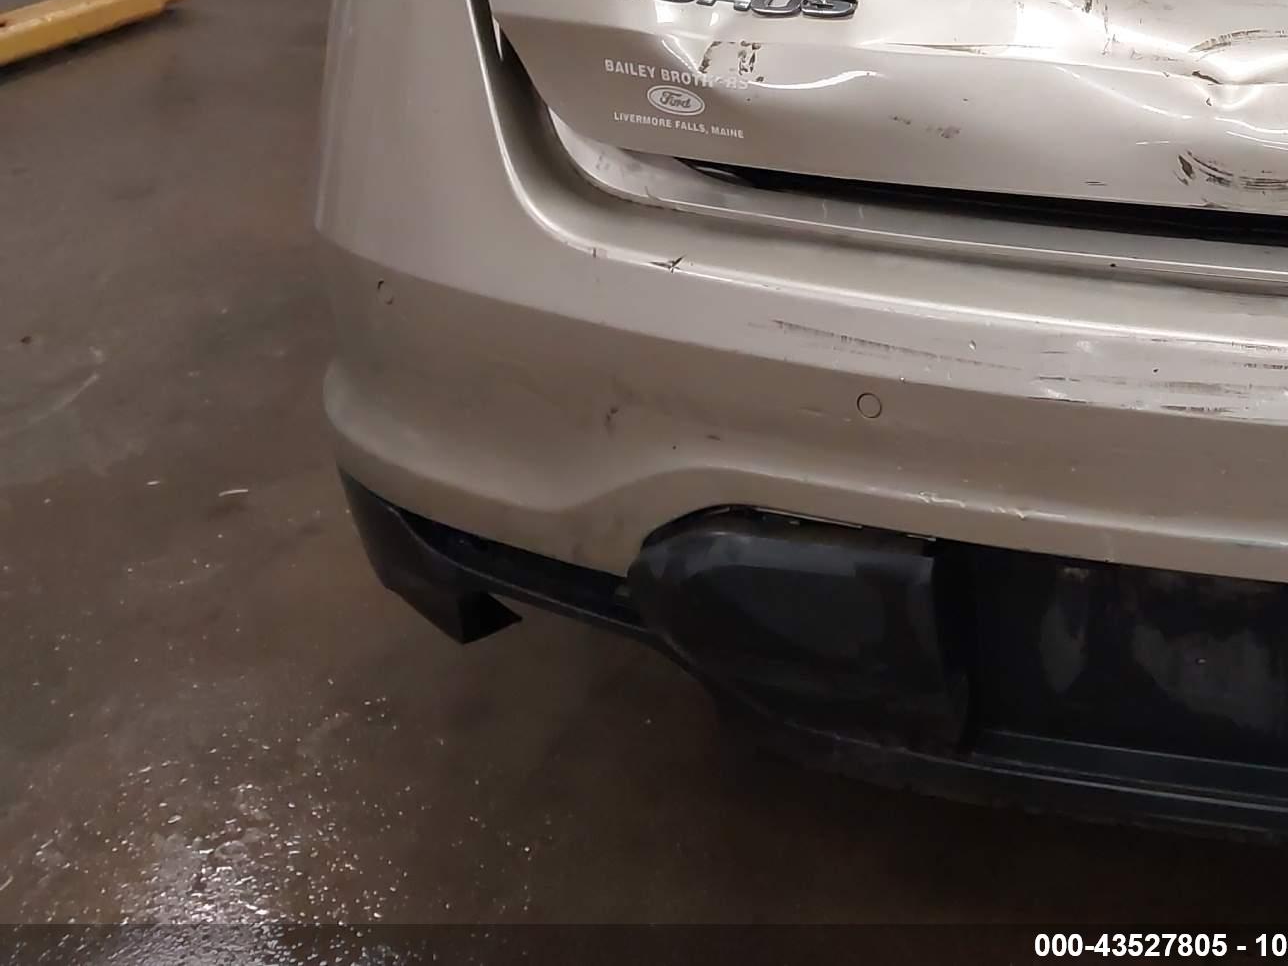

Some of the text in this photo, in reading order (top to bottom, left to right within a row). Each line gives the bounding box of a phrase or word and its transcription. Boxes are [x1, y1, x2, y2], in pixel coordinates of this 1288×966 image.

[604, 58, 656, 79] BAILEY
[659, 90, 692, 109] Ford
[613, 111, 745, 139] LIVERMORE FALLS, MAINE
